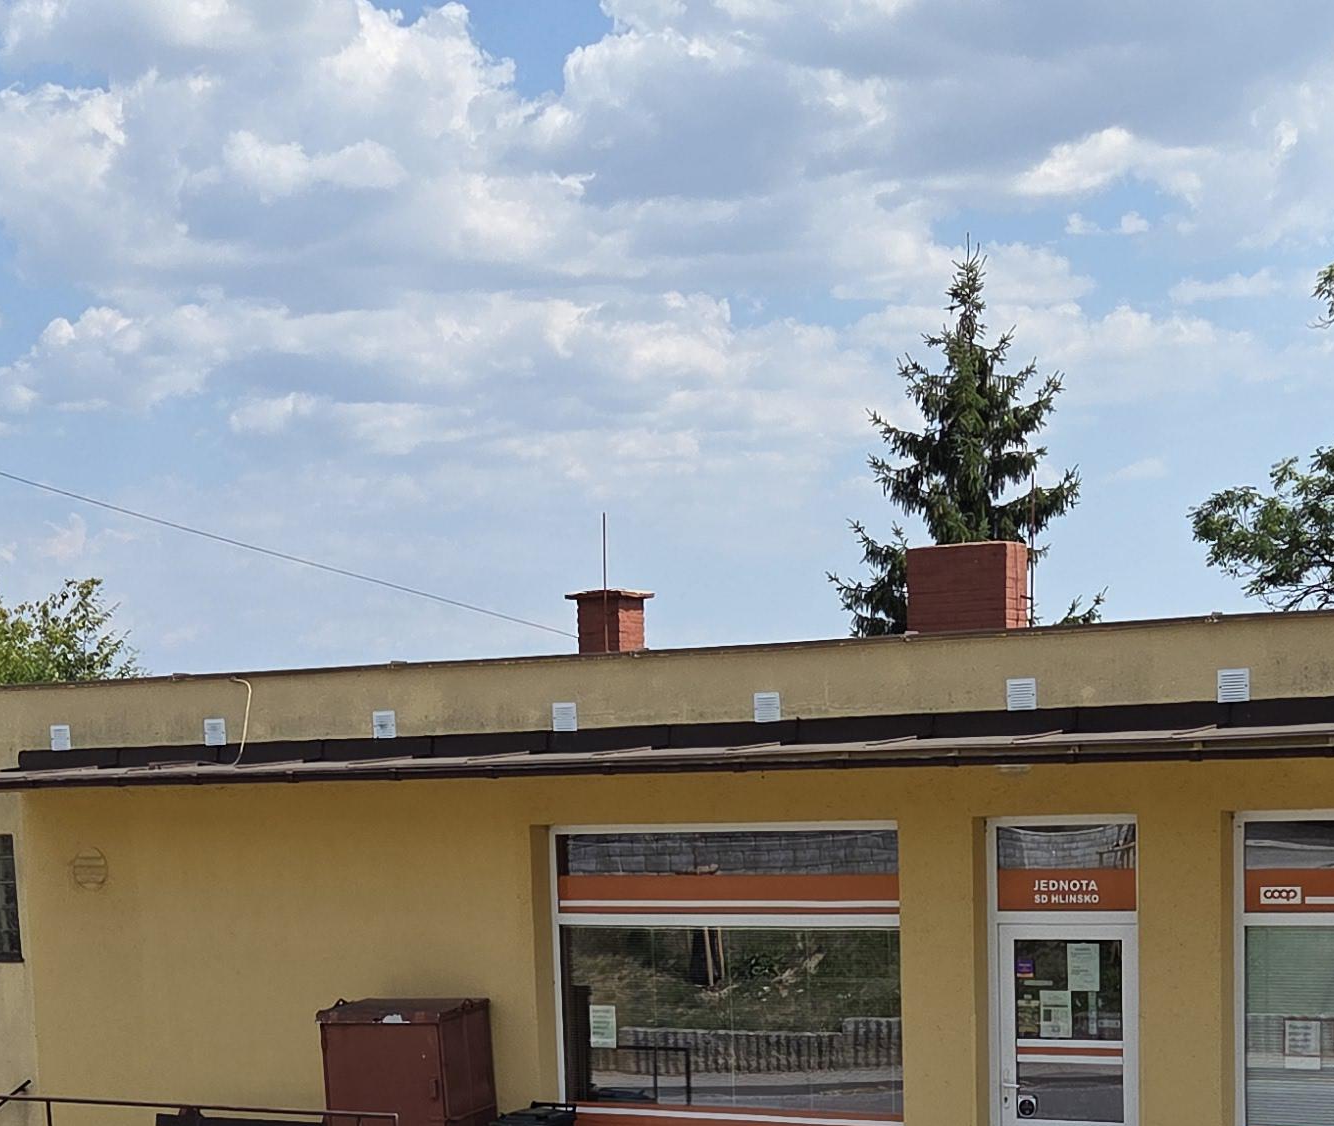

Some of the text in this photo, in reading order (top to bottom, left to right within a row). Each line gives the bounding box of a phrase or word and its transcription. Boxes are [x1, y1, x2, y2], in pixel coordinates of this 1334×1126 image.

[1033, 879, 1099, 892] JEDNOTA
[1034, 894, 1100, 904] SD HLINSKO
[1263, 889, 1298, 902] coop
